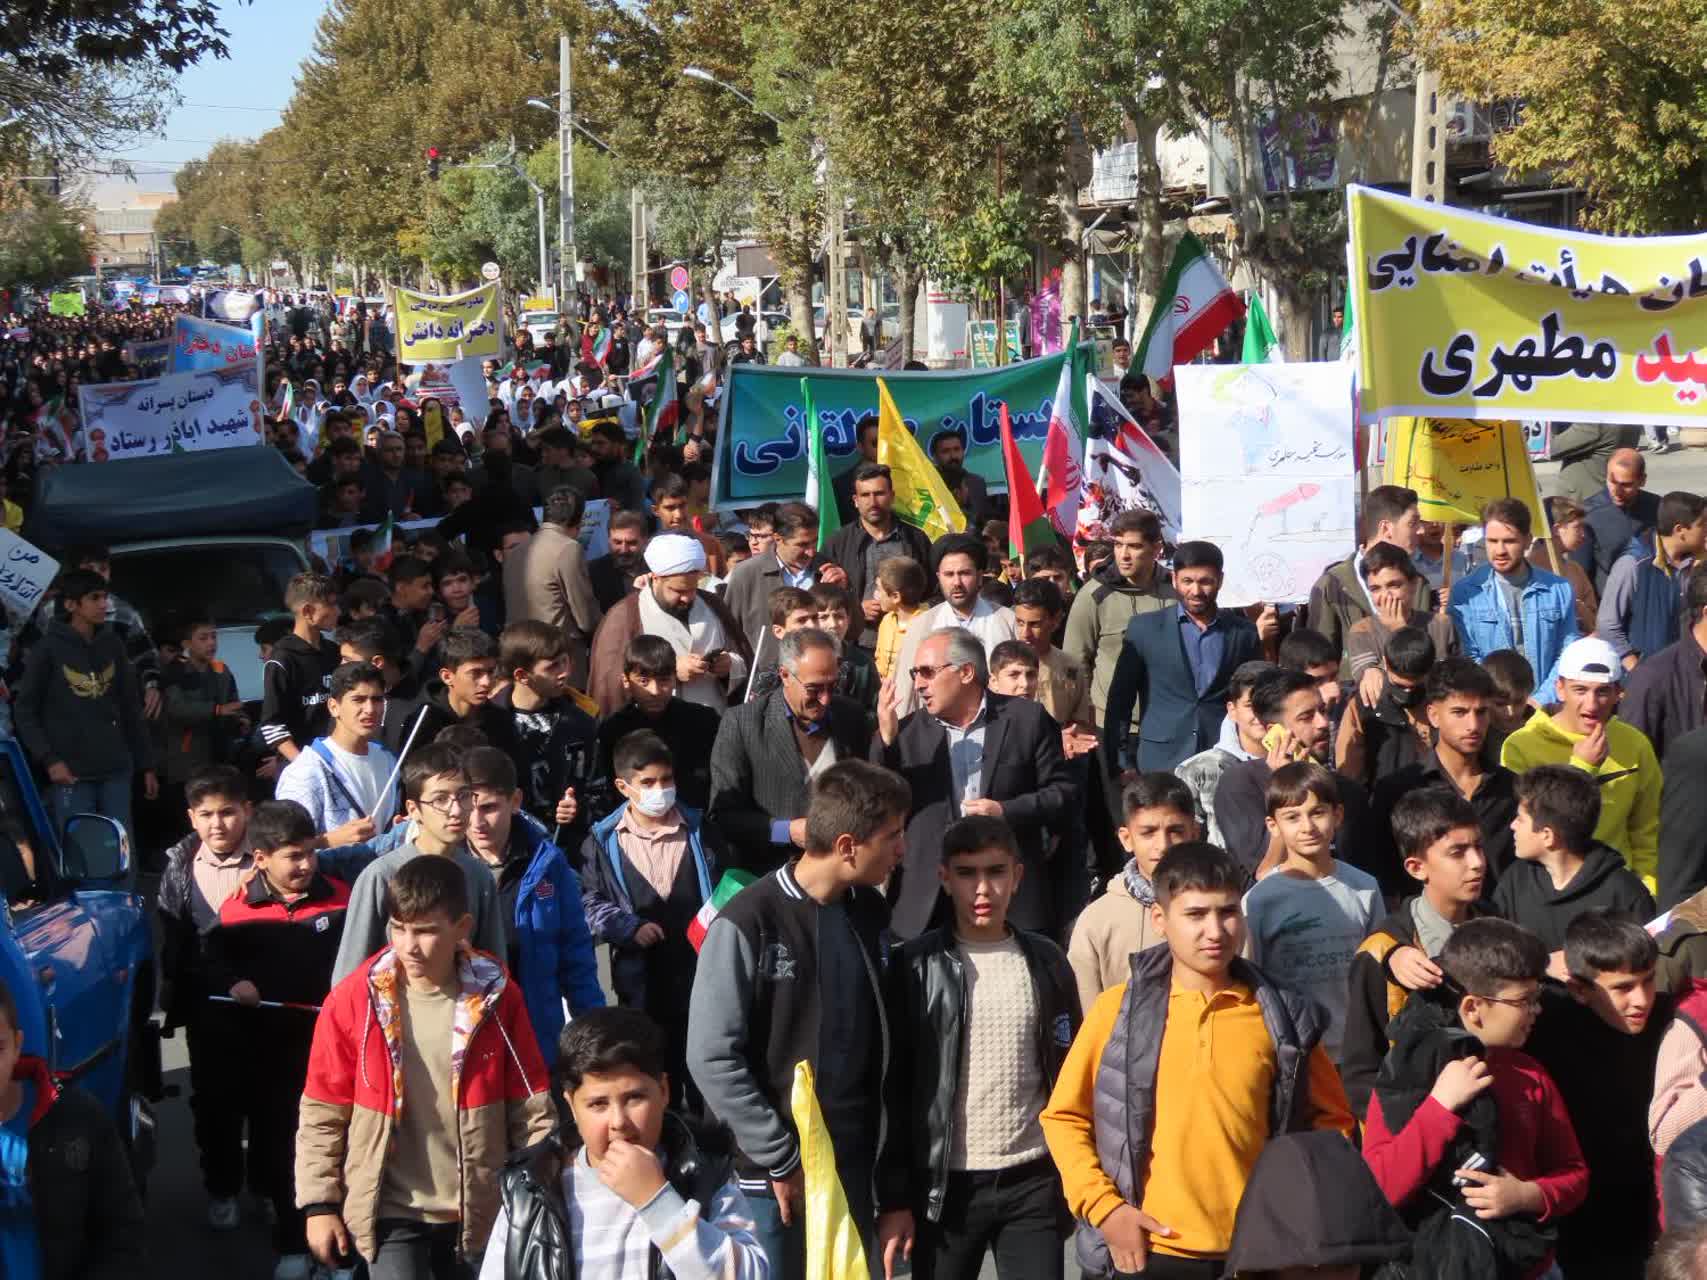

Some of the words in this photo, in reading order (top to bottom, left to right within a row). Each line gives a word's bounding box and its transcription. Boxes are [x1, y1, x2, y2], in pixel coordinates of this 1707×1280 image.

[404, 321, 443, 346] دانش
[1420, 312, 1617, 397] مطهری
[1636, 333, 1707, 401] ید
[207, 410, 249, 437] شهید
[735, 405, 919, 475] لقانی
